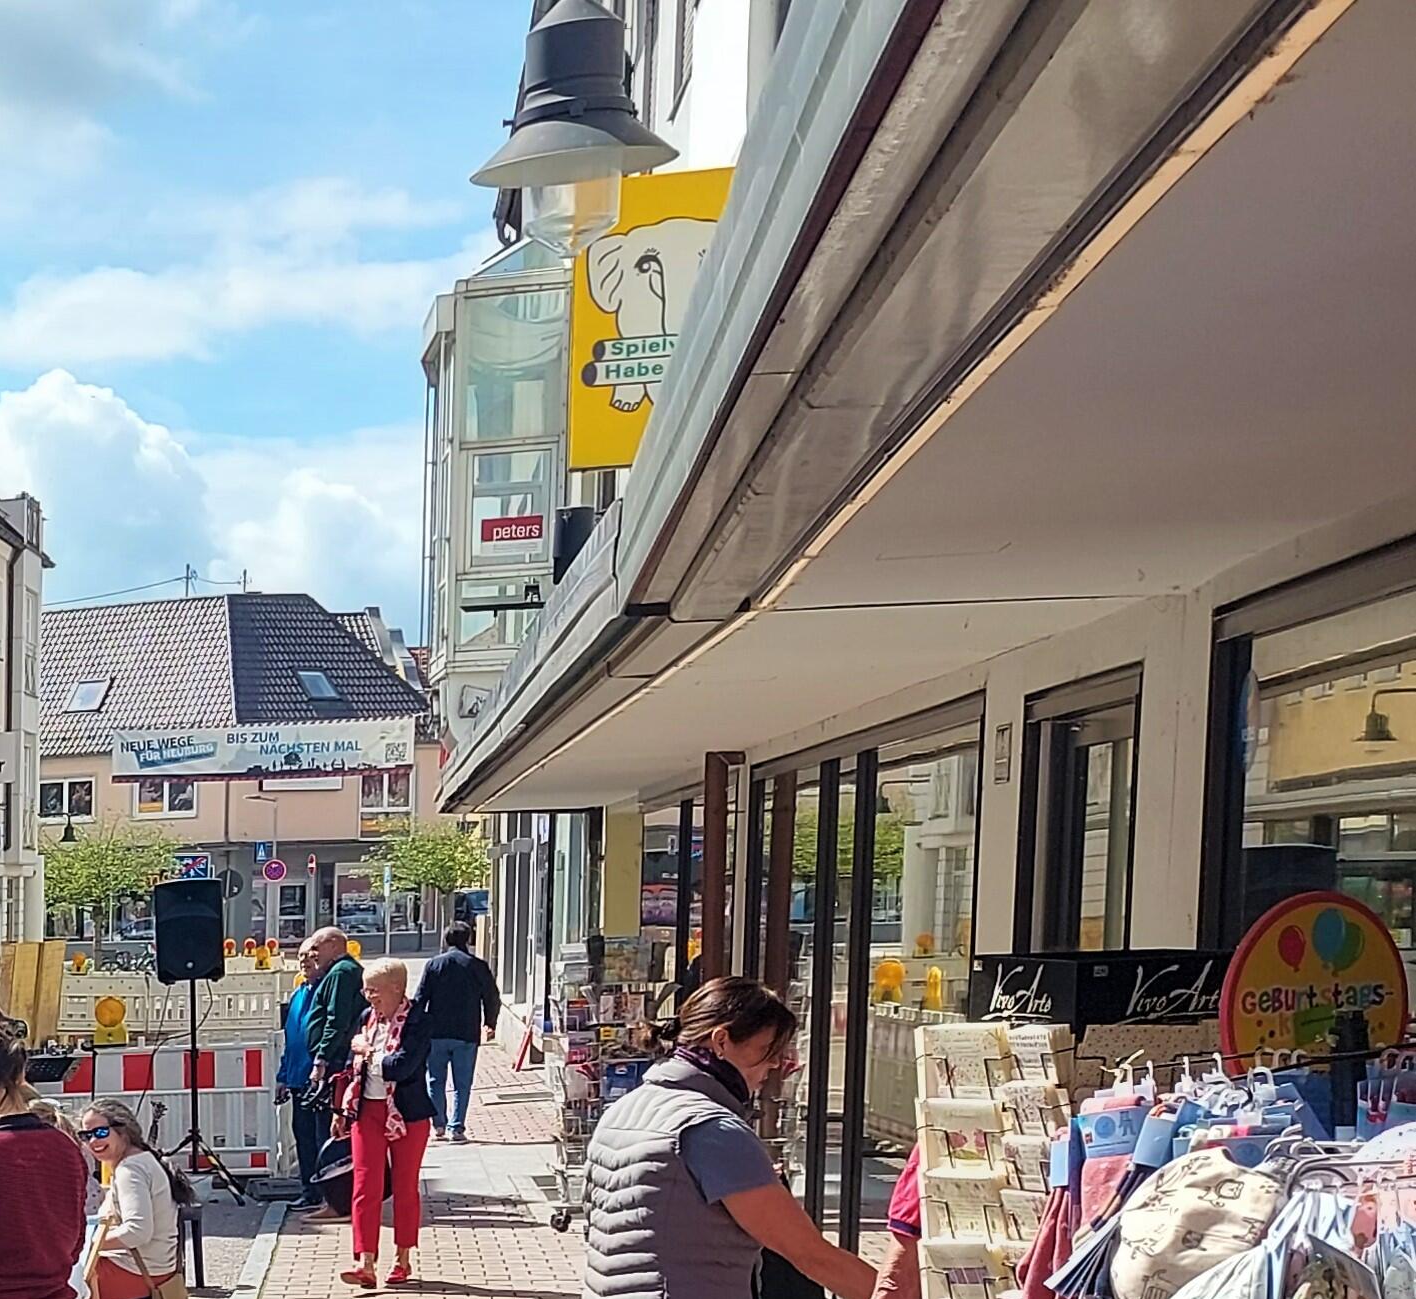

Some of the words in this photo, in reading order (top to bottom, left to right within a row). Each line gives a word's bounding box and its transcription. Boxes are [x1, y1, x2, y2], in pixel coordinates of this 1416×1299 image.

[611, 338, 675, 357] Spiel
[493, 524, 540, 541] peters
[120, 739, 155, 753] NEUE
[157, 735, 195, 749] WEGE
[226, 732, 248, 744] BIS
[250, 731, 279, 743] ZUM
[140, 749, 161, 762] FÜR
[163, 743, 215, 759] NEUBURG
[259, 740, 332, 755] NÄCHSTEN
[334, 740, 363, 752] MAL
